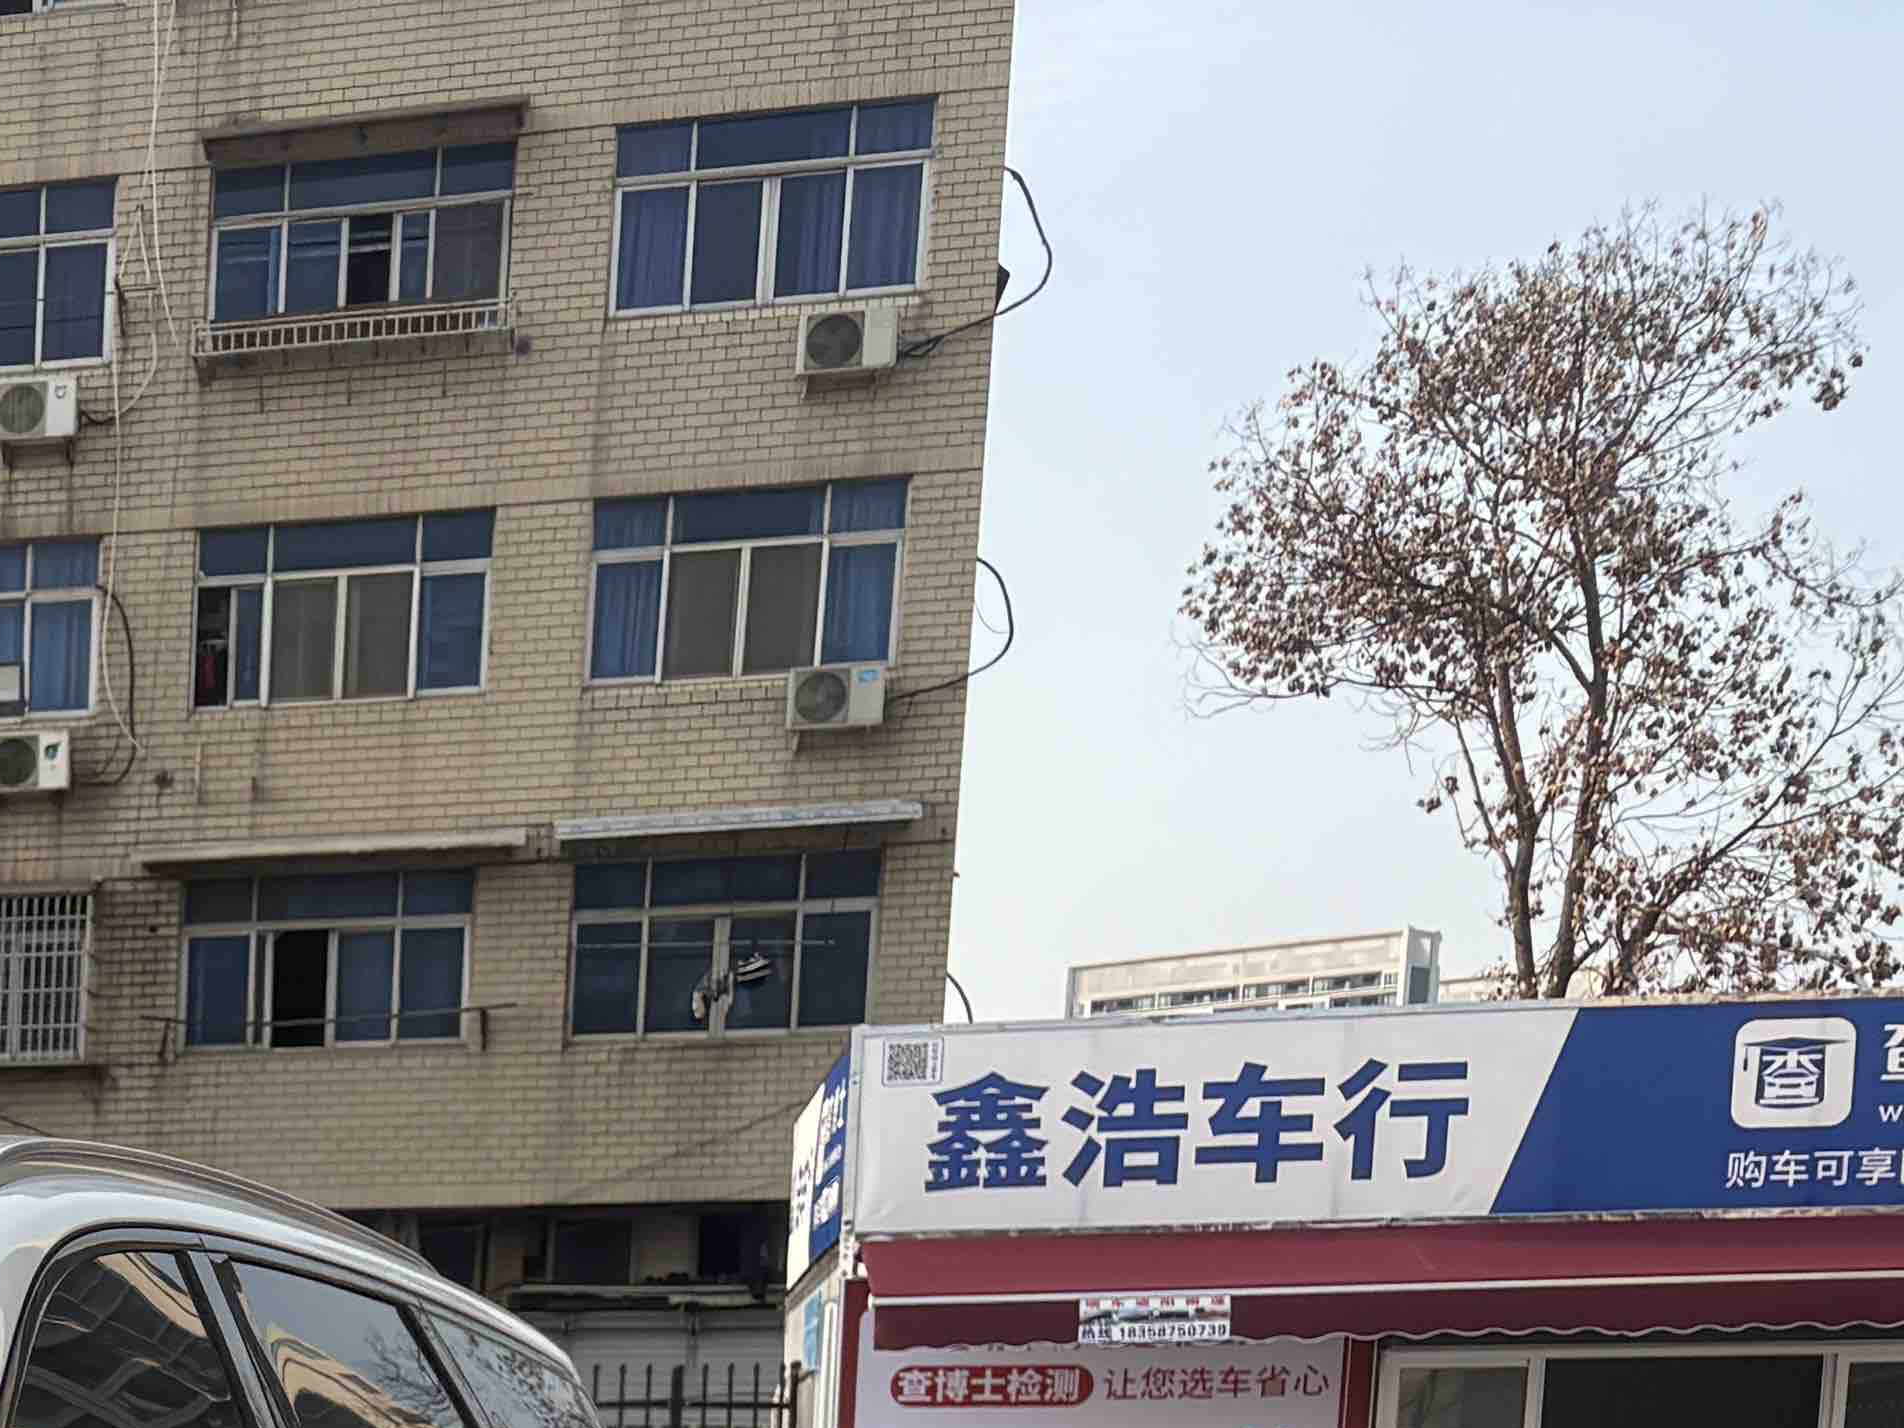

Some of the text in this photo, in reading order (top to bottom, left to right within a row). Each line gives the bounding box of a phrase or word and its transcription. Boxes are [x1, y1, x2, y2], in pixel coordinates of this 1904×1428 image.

[924, 1058, 1470, 1193] 鑫浩车行
[1725, 1147, 1904, 1189] 购车可享
[898, 1367, 1081, 1402] 查博士检测
[1103, 1364, 1330, 1401] 让您选车省心
